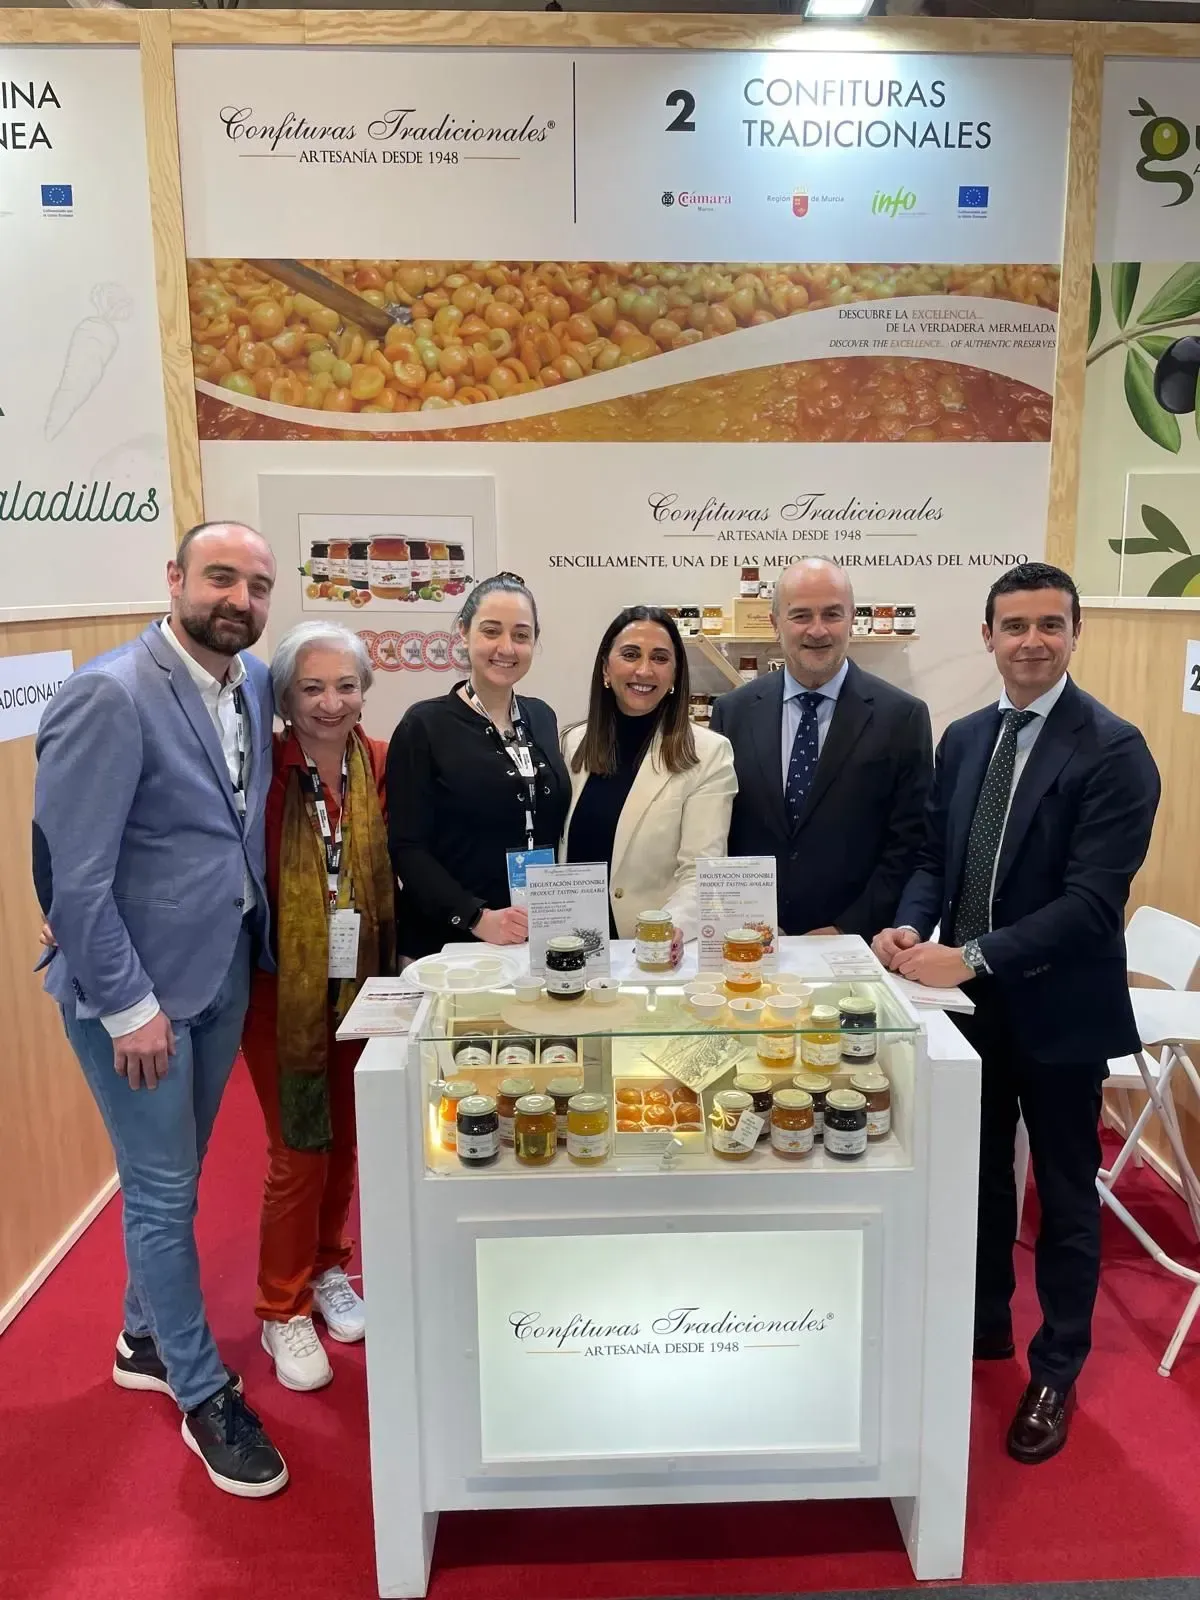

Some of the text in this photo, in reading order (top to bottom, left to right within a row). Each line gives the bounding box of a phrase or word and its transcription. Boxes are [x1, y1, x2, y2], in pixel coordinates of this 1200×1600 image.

[2, 81, 61, 109] INA
[743, 78, 946, 108] CONFITURAS
[665, 89, 696, 132] 2
[219, 105, 357, 151] Confituras
[742, 119, 992, 150] TRADICIONALES
[299, 149, 459, 164] ARTESANÍA DESDE 1948
[678, 191, 732, 207] Cámara
[871, 185, 917, 218] info
[838, 309, 892, 320] DESCUBRE
[895, 309, 908, 320] LA
[886, 323, 1056, 333] DE LA VERDADERA MERMELADA
[829, 339, 869, 348] DISCOVER
[873, 339, 888, 348] THE
[950, 339, 960, 348] OF
[964, 339, 1011, 348] AUTHENTIC
[1013, 339, 1056, 348] PRESERVES
[647, 491, 944, 532] Confituras Tradicionales
[717, 528, 862, 541] ARTESANÍA DESDE 1948
[549, 555, 668, 568] SENCILLAMENTE,
[672, 555, 705, 567] UNA
[710, 555, 728, 567] DE
[733, 555, 759, 567] LAS
[832, 554, 932, 567] MERMELADAS
[937, 554, 961, 566] DEL
[968, 553, 1028, 566] MUNDO
[508, 1310, 642, 1349] Confituras
[584, 1341, 740, 1357] ARTESANÍA DESDE 1948
